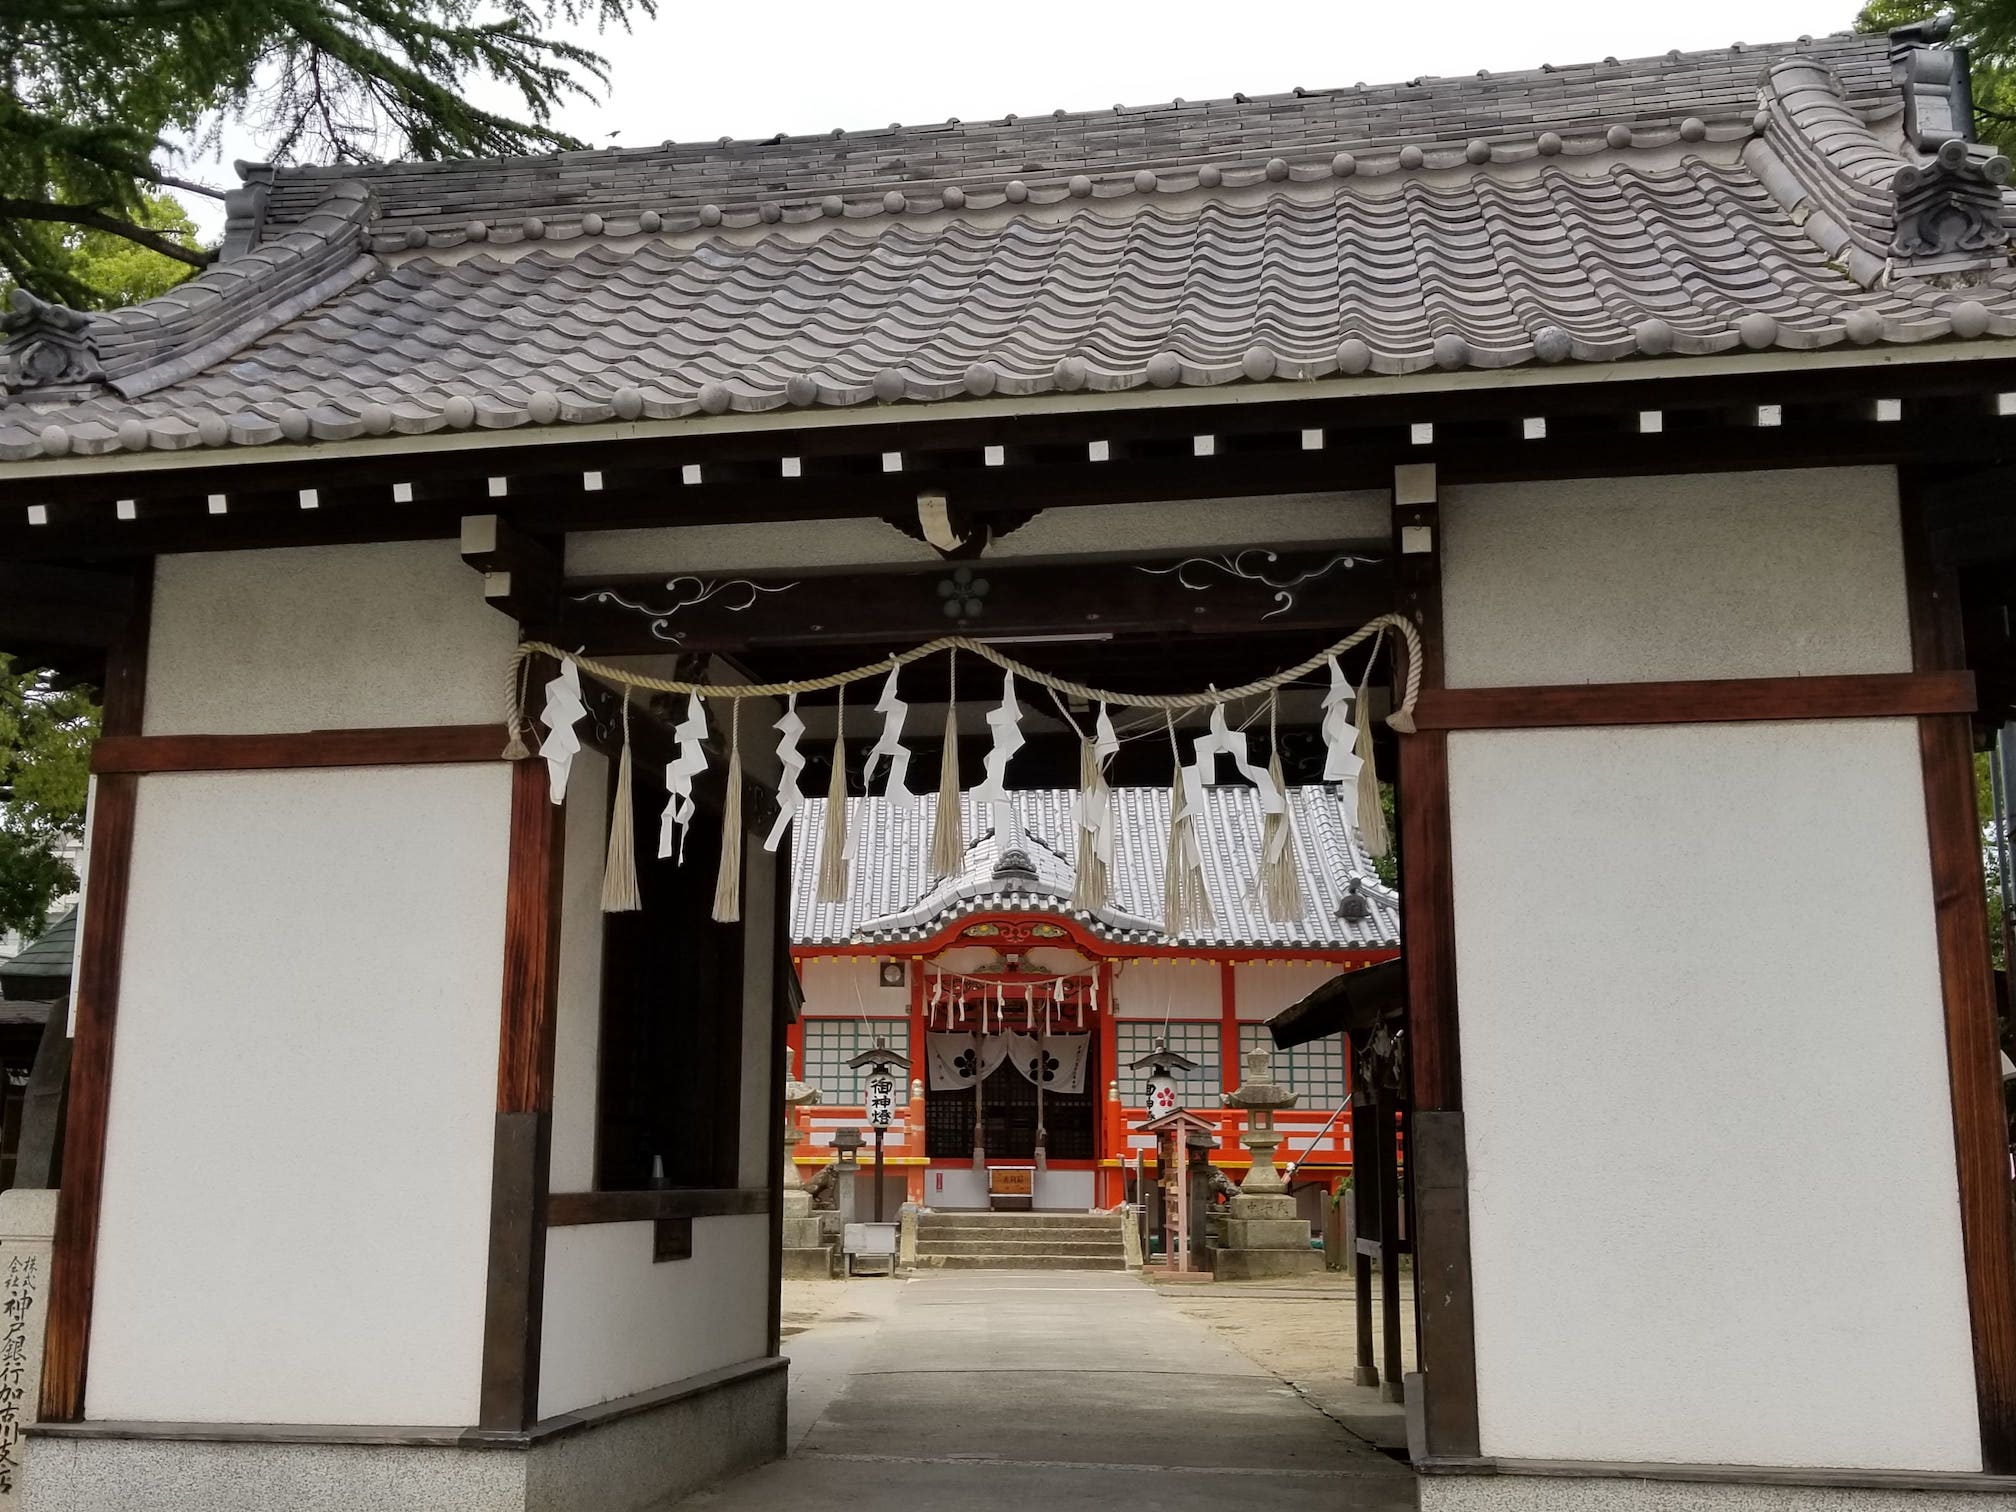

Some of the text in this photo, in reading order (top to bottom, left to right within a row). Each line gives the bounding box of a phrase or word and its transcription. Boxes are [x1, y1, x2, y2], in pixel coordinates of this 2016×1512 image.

[870, 1077, 893, 1125] 御神燈
[4, 1256, 23, 1288] 会社
[23, 1256, 38, 1290] 株式
